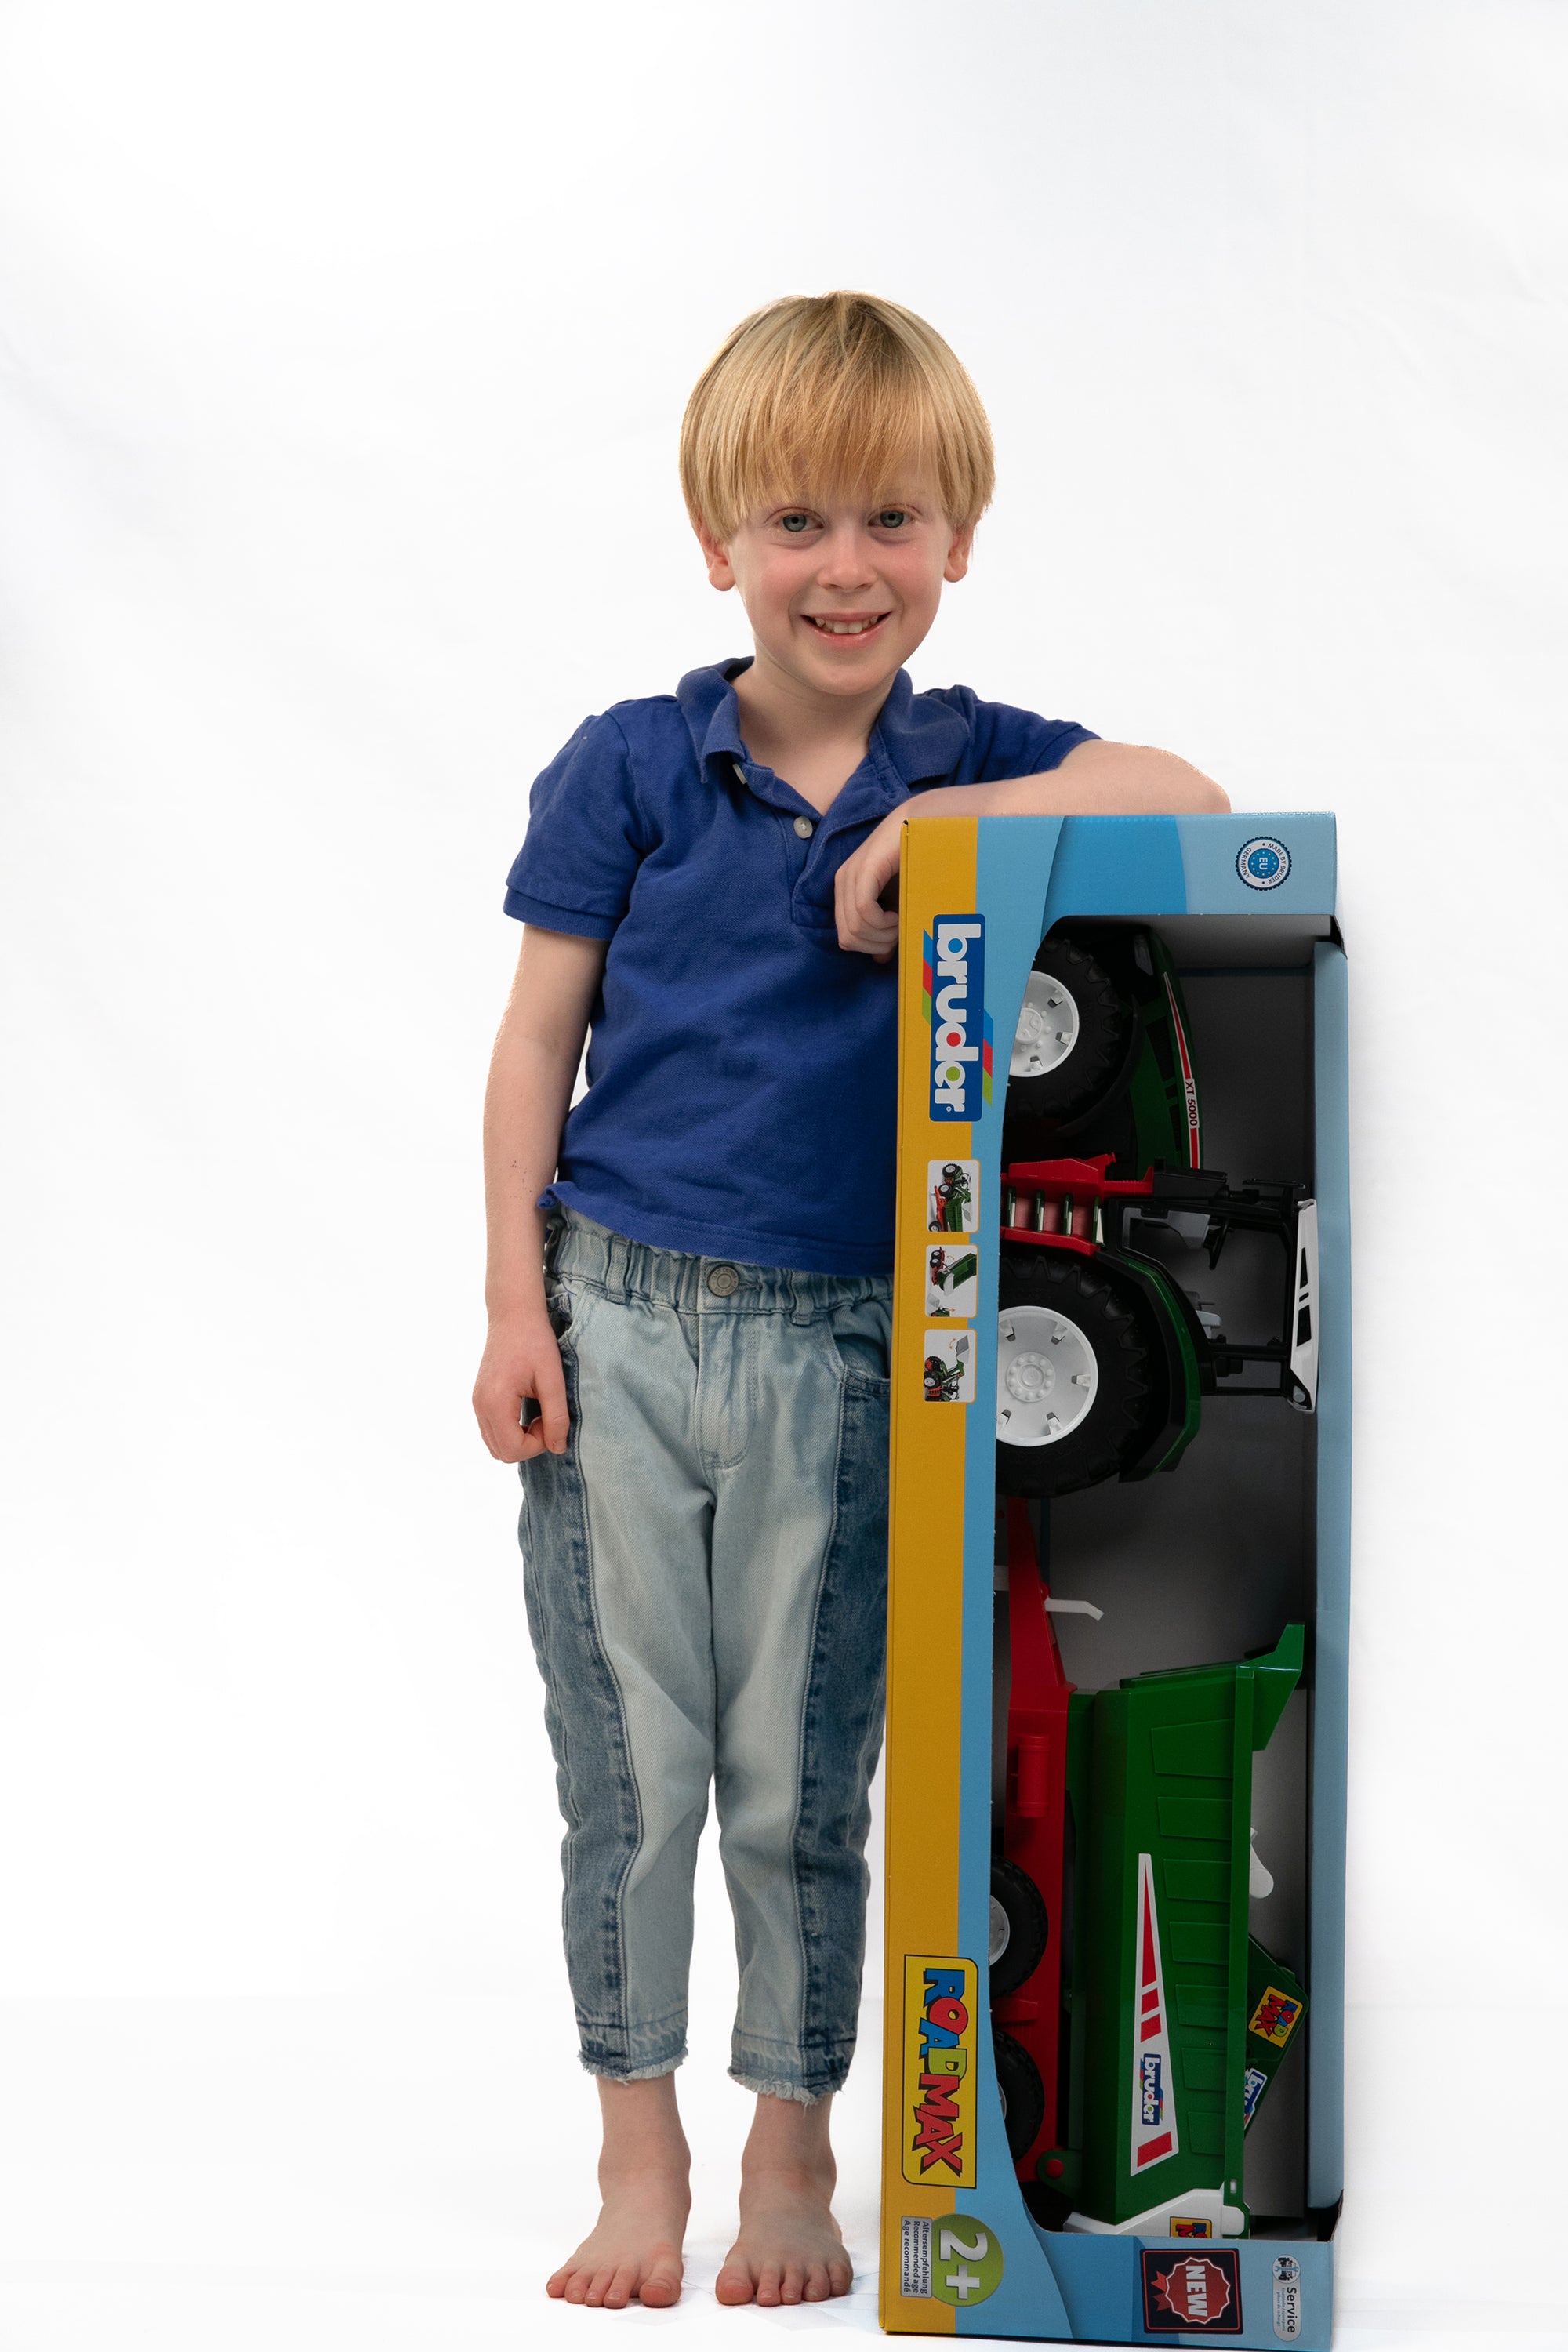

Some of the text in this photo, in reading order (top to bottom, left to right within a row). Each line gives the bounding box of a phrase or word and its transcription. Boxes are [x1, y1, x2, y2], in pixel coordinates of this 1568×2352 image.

[1240, 847, 1252, 879] GERMANY
[1259, 857, 1268, 870] EU
[1268, 843, 1287, 884] MADE BY BRUDER
[1185, 1081, 1198, 1127] XT 5000
[1254, 1994, 1287, 2038] MAX
[1143, 2056, 1160, 2123] bruder
[902, 2220, 912, 2292] Age recommandé
[913, 2220, 921, 2278] Recommended
[920, 2220, 930, 2295] Altersempfehlung
[939, 2228, 989, 2299] 2+
[1185, 2265, 1208, 2317] NEW
[1287, 2286, 1298, 2333] Service
